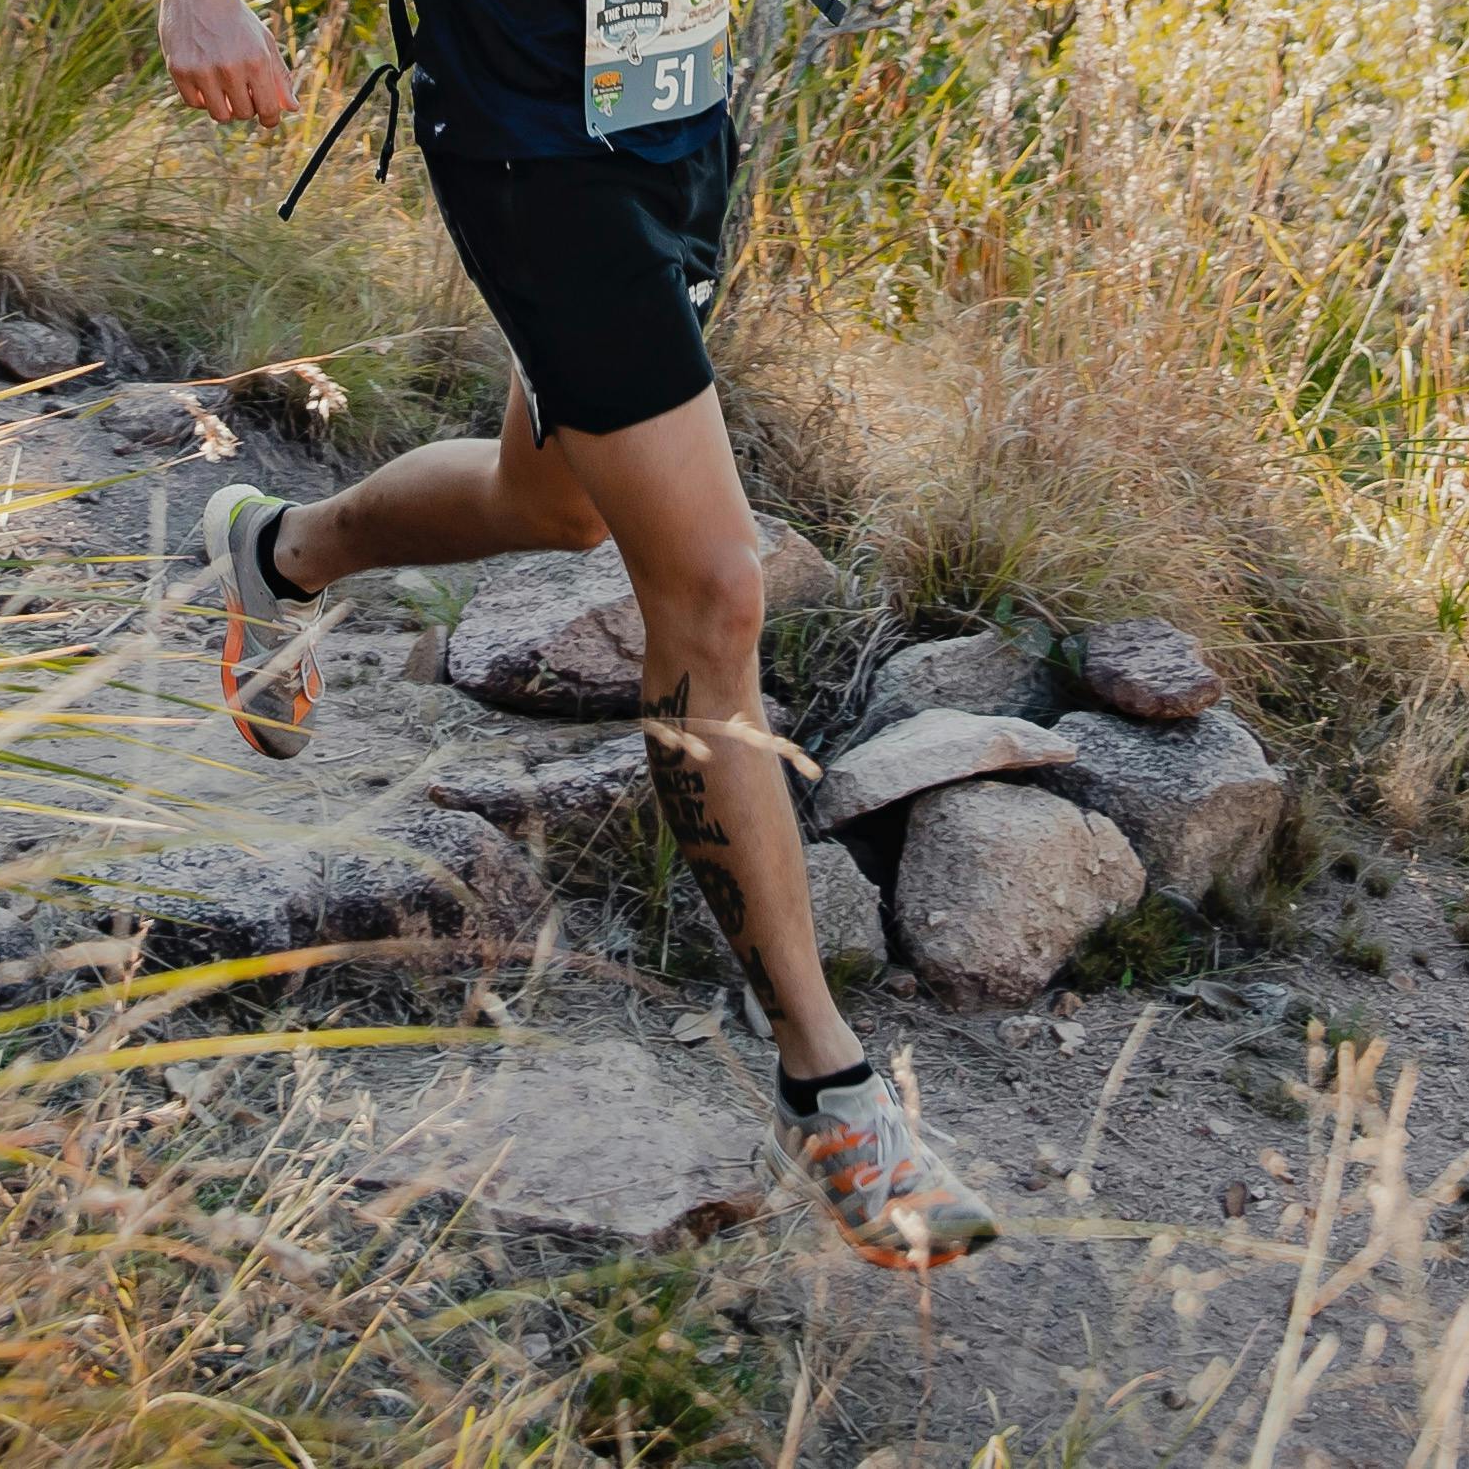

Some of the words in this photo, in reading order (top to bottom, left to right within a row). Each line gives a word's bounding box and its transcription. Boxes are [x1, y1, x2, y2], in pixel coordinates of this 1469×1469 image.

[603, 6, 621, 23] THE
[622, 2, 641, 18] TWO
[651, 53, 695, 111] 51
